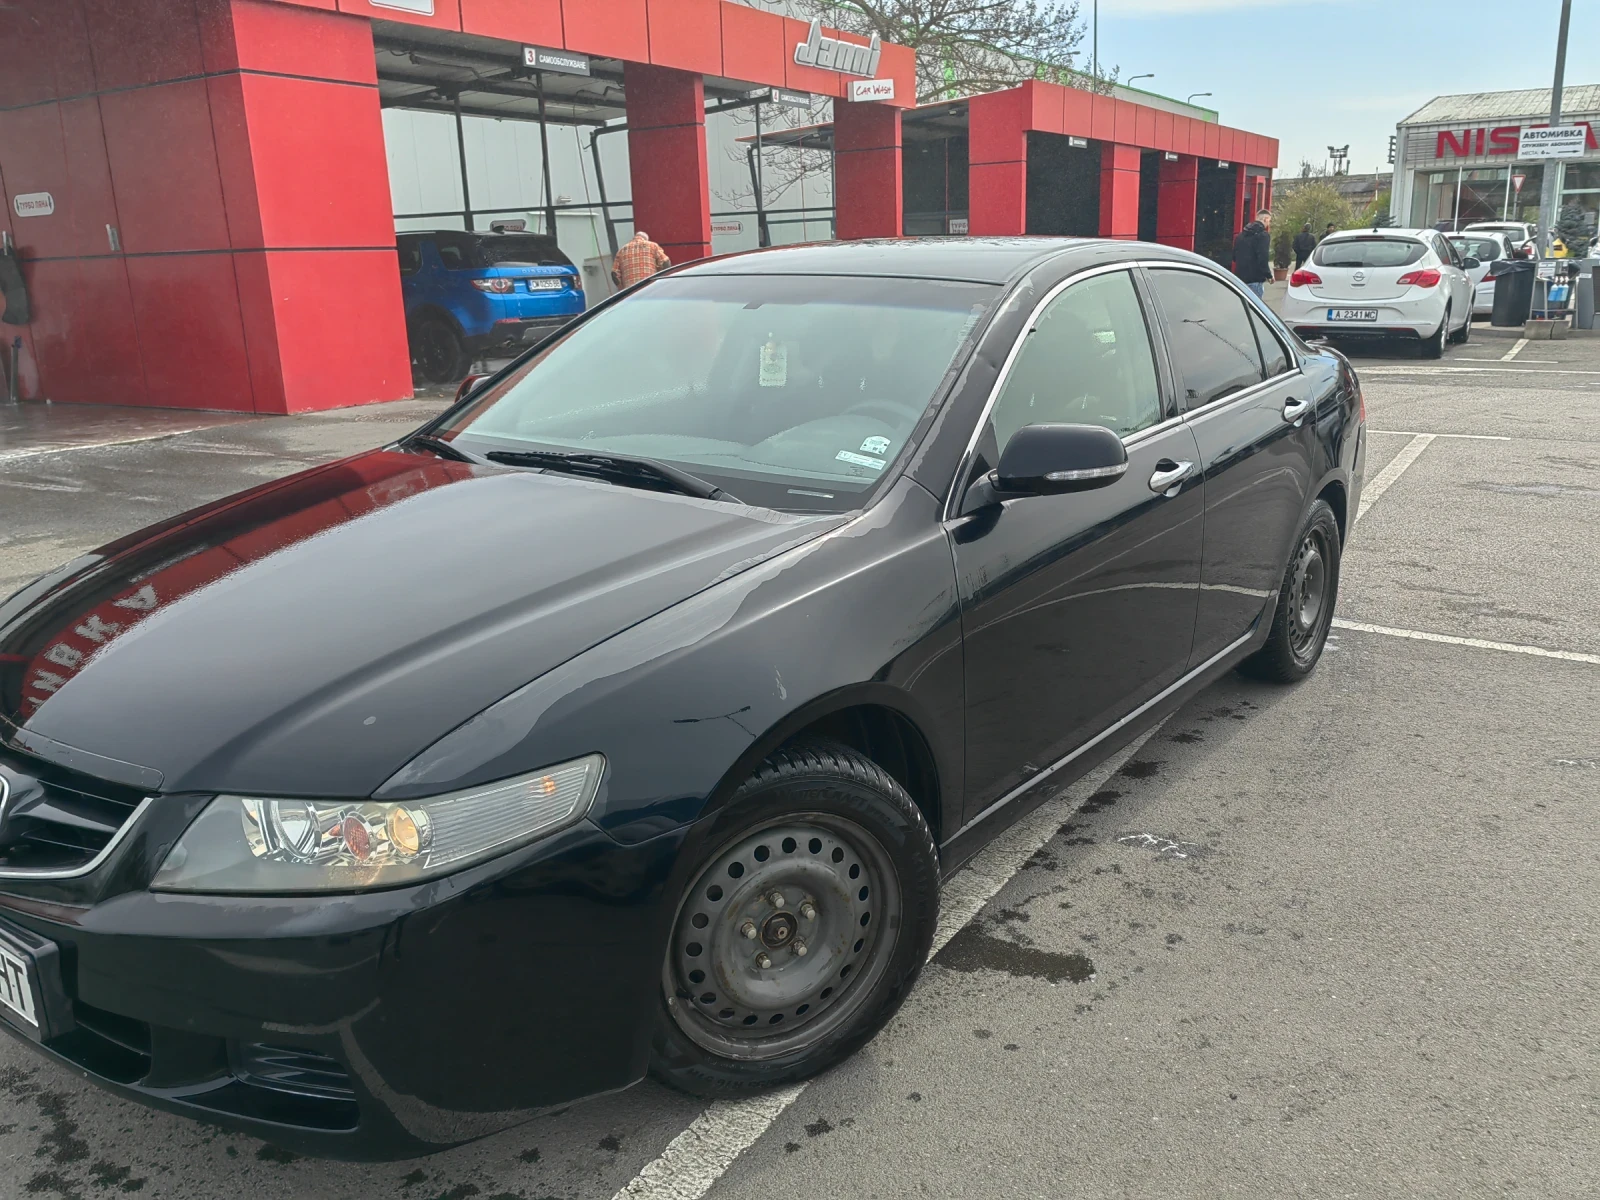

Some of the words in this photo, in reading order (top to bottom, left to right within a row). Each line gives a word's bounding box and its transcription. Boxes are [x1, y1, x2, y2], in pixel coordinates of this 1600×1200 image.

[527, 50, 534, 62] 3
[1522, 129, 1583, 140] АВТОМИВКА
[1335, 310, 1341, 319] A
[1344, 310, 1362, 319] 2341
[1364, 311, 1376, 319] MC
